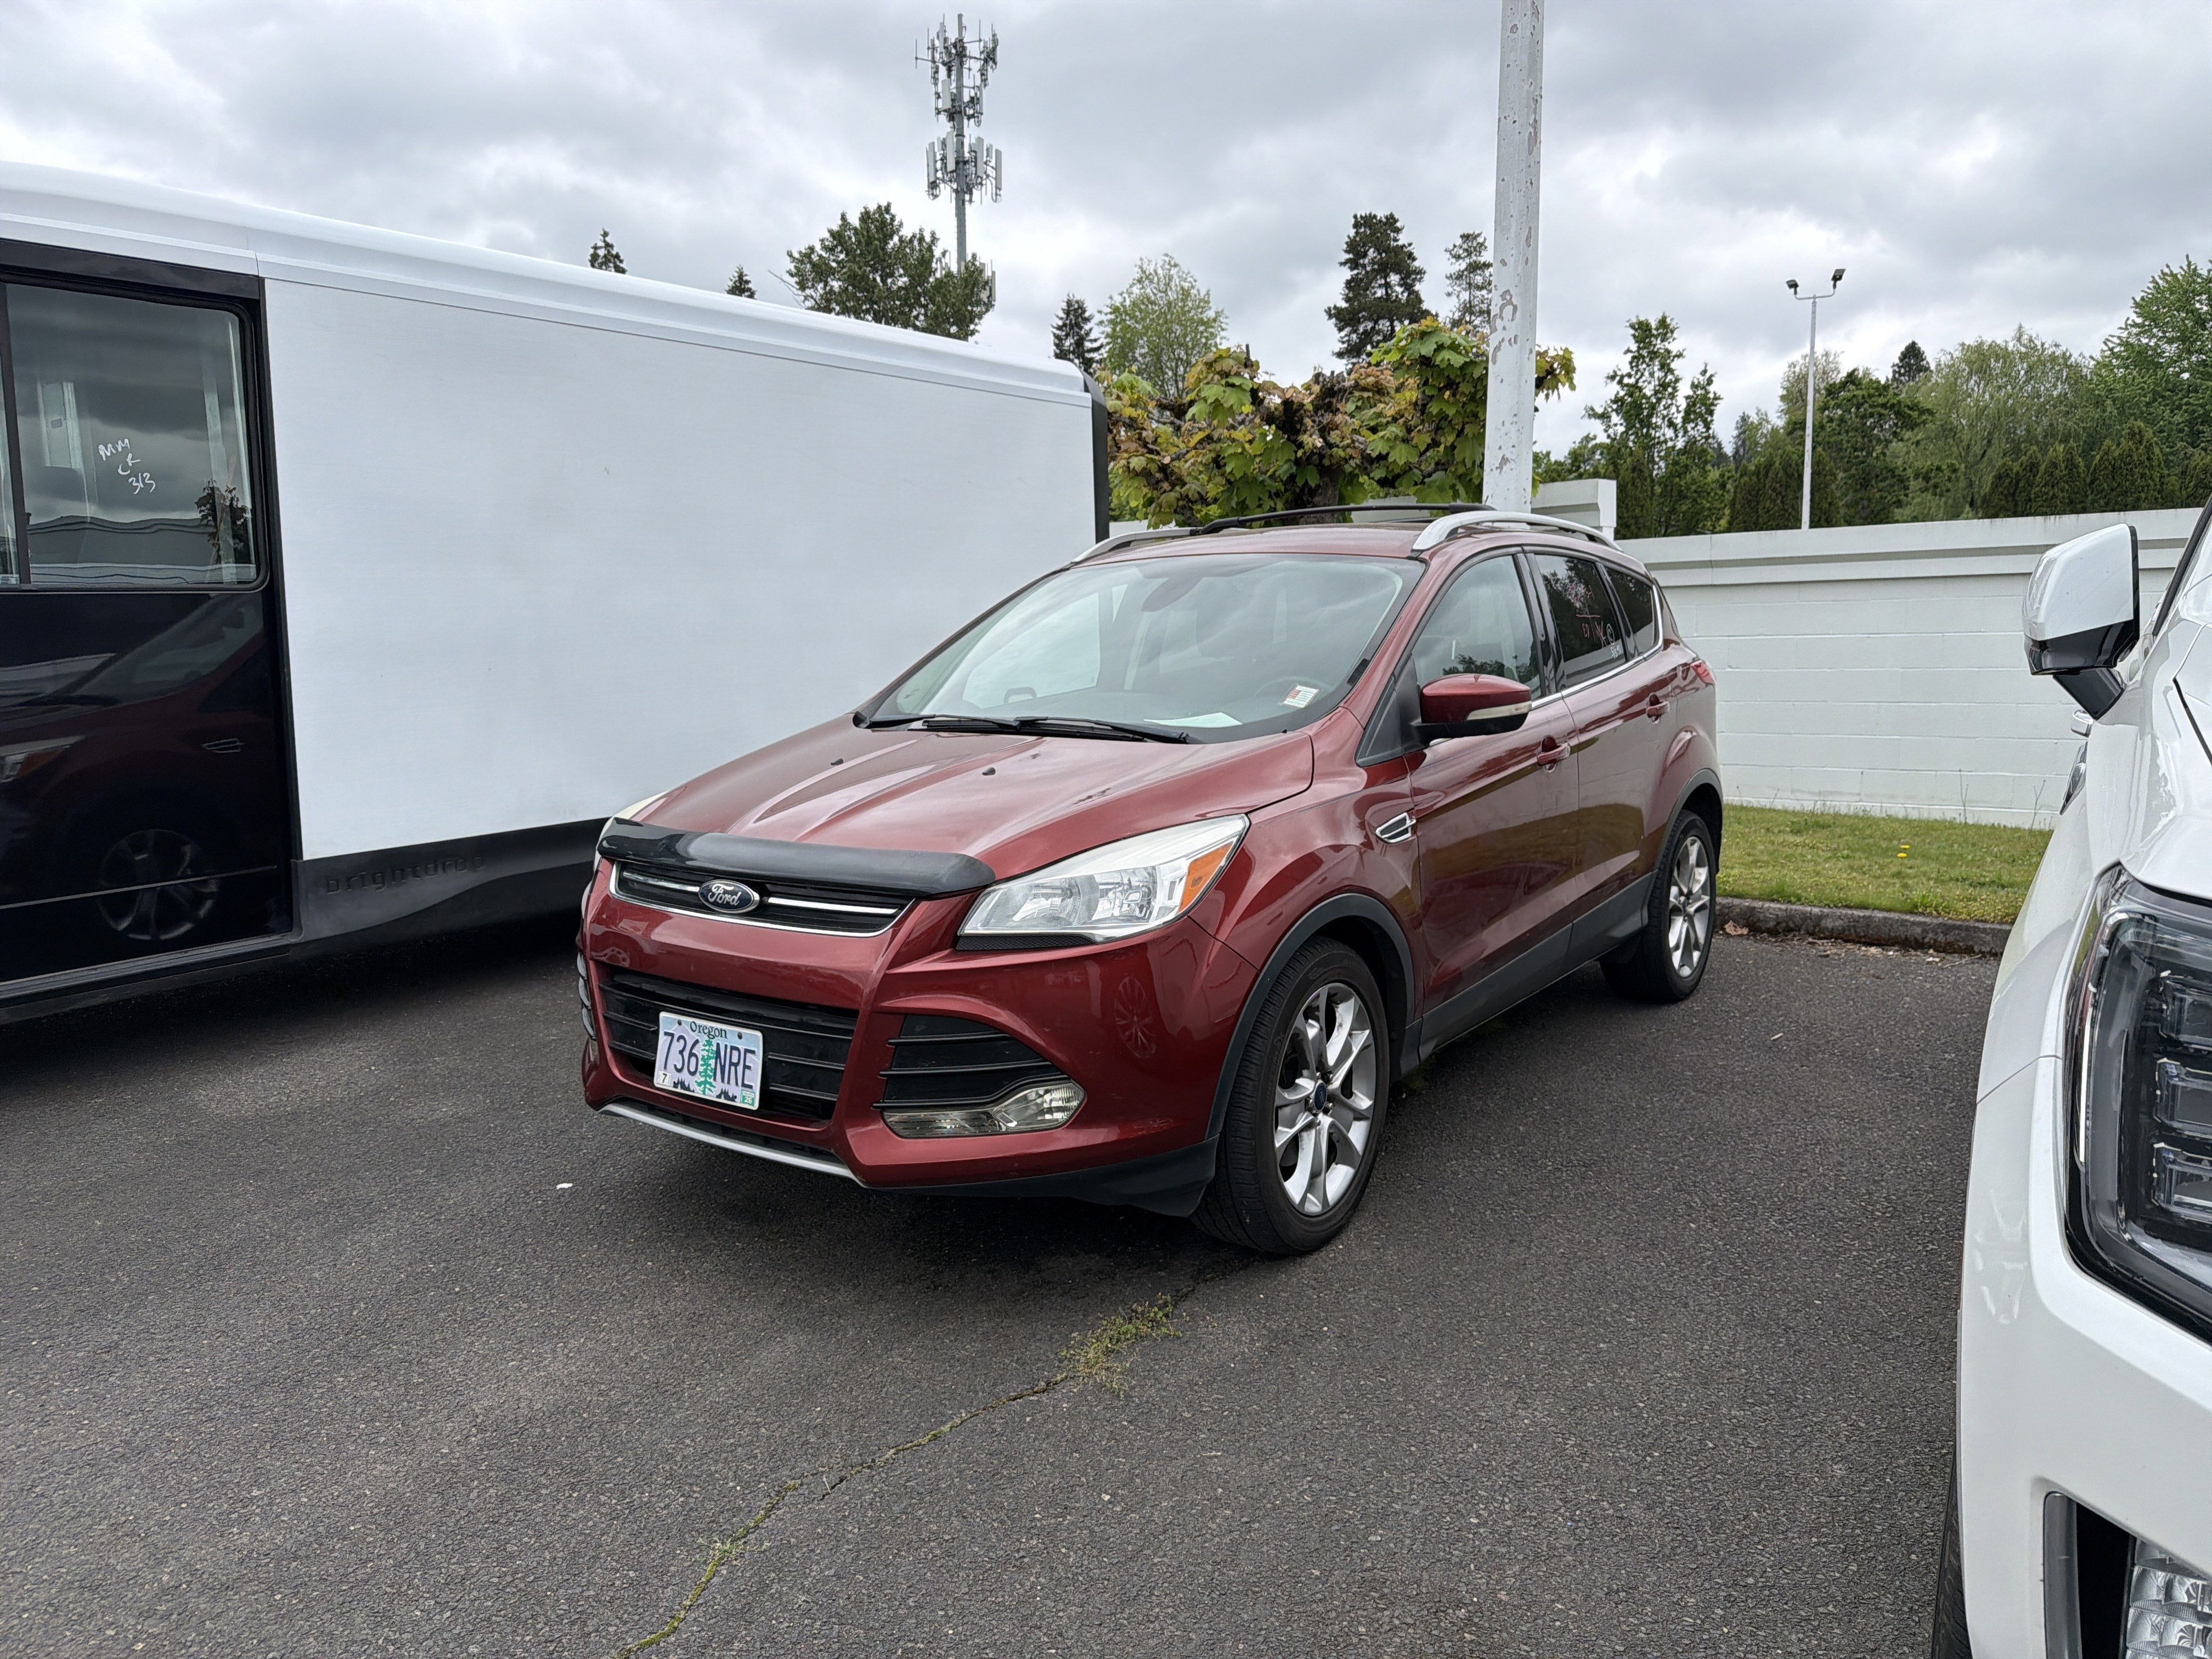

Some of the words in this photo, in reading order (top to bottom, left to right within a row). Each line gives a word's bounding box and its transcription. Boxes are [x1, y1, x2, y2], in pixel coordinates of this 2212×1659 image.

[708, 883, 742, 906] Ford
[690, 1021, 728, 1040] Oregon
[663, 1031, 700, 1076] 736
[713, 1042, 756, 1090] NRE
[662, 1073, 668, 1084] 7
